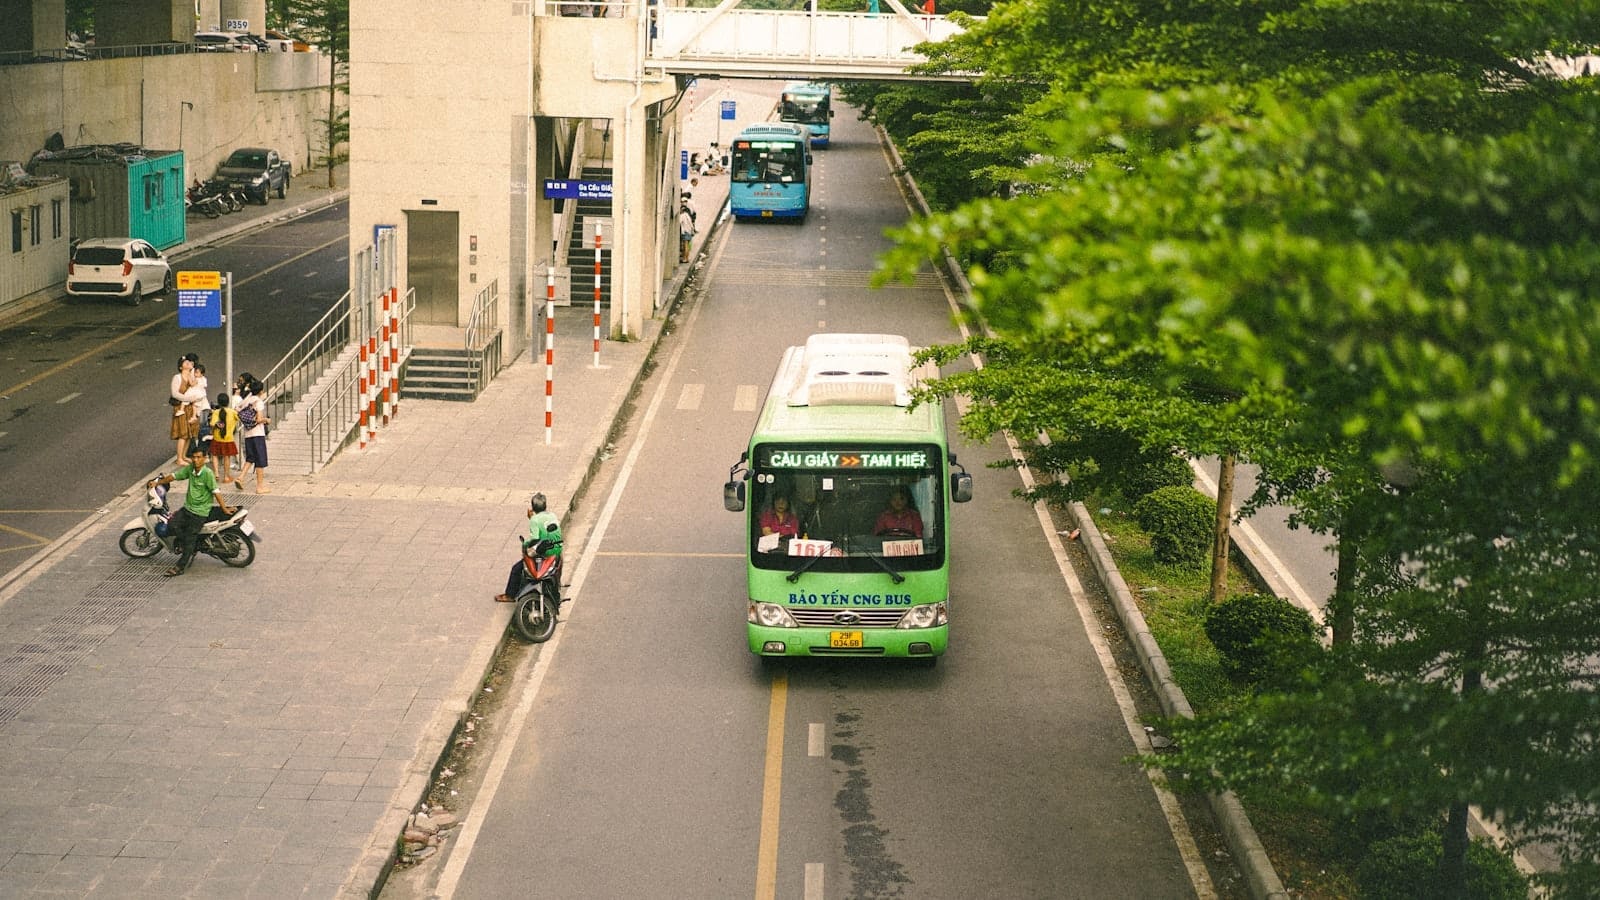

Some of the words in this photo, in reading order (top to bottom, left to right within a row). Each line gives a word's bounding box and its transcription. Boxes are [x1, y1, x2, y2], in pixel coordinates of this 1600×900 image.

[227, 20, 247, 29] P359
[771, 452, 801, 467] CẦU
[805, 452, 839, 467] GIẤY
[861, 454, 892, 467] TAM
[789, 589, 817, 604] BẢO
[821, 589, 849, 605] YẾN
[853, 594, 881, 605] CNG
[885, 594, 912, 605] BUS
